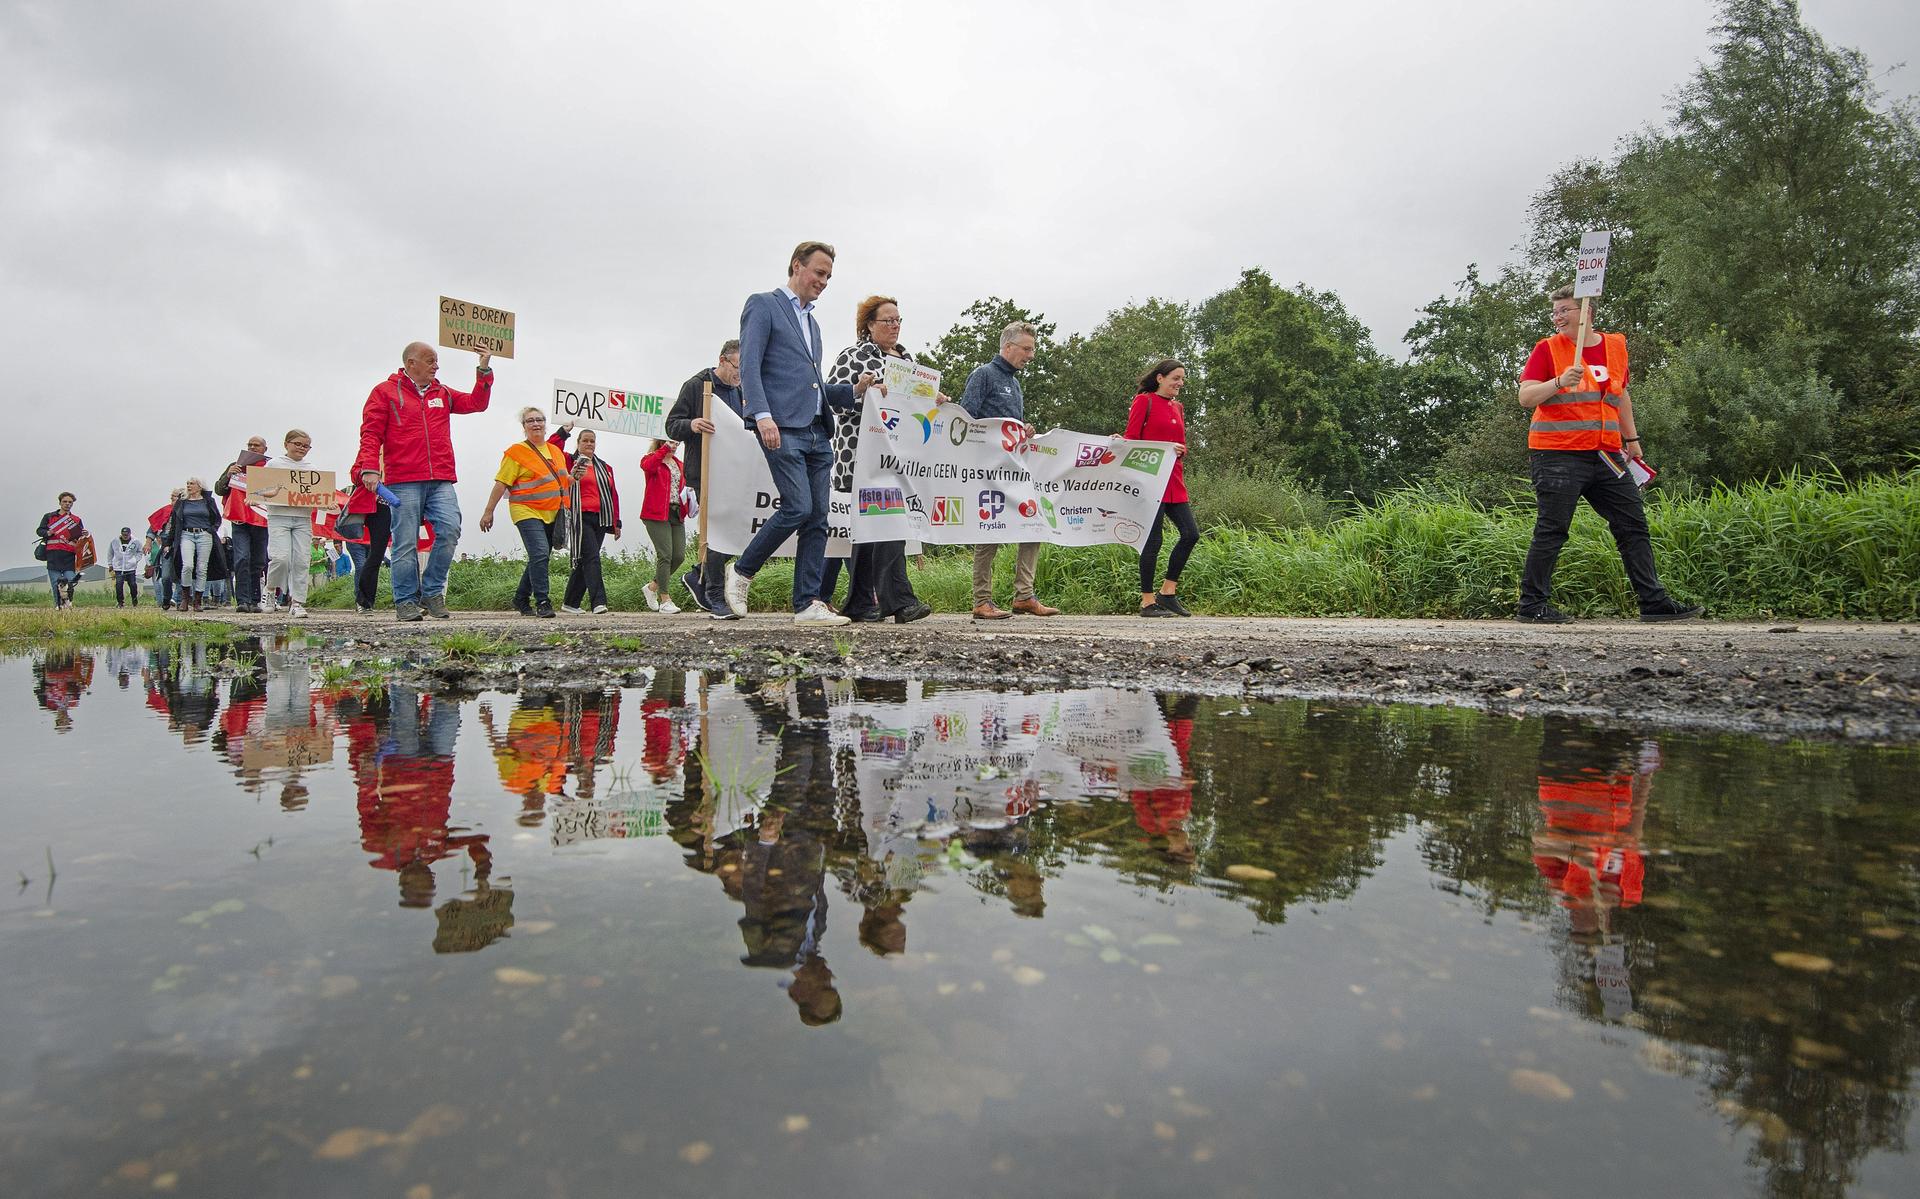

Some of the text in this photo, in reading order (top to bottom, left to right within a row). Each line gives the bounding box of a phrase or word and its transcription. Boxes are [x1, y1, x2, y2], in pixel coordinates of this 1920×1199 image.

[1579, 258, 1603, 270] BLOK
[1581, 274, 1598, 284] gezet
[440, 300, 508, 325] GAS BOREN
[555, 389, 606, 421] FOAR
[1128, 450, 1160, 464] D66
[290, 470, 321, 485] RED
[934, 463, 957, 479] GEEN
[961, 466, 1031, 483] gaswinnin
[1045, 481, 1059, 493] de
[1063, 479, 1140, 497] Waddenzee
[299, 485, 312, 494] DE
[756, 491, 781, 509] De
[1060, 506, 1093, 516] Christen
[979, 521, 1007, 531] Fryslân
[1067, 516, 1084, 525] Unie
